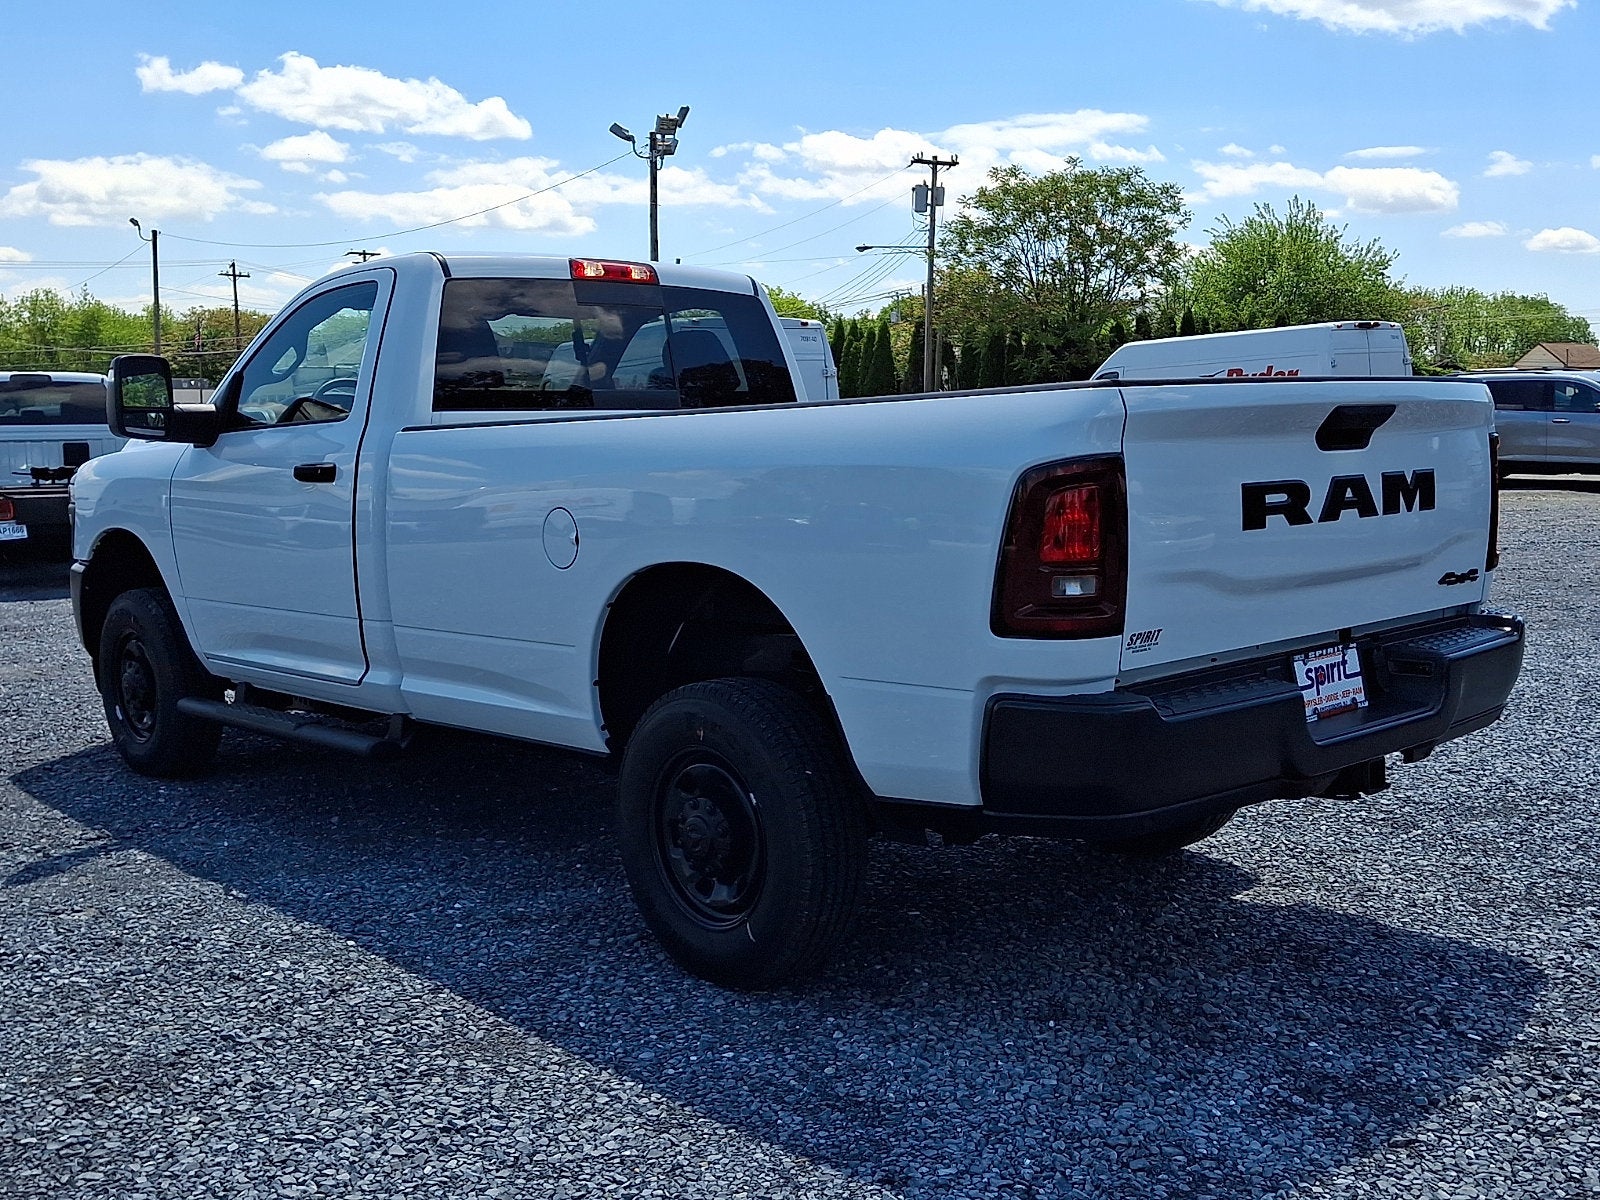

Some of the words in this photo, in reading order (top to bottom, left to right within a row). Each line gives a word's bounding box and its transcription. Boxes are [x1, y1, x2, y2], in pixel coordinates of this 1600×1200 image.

[1227, 365, 1299, 377] Rder
[1241, 469, 1436, 531] RAM
[1126, 628, 1163, 646] SPIRIT
[1308, 645, 1343, 658] SPIRIT
